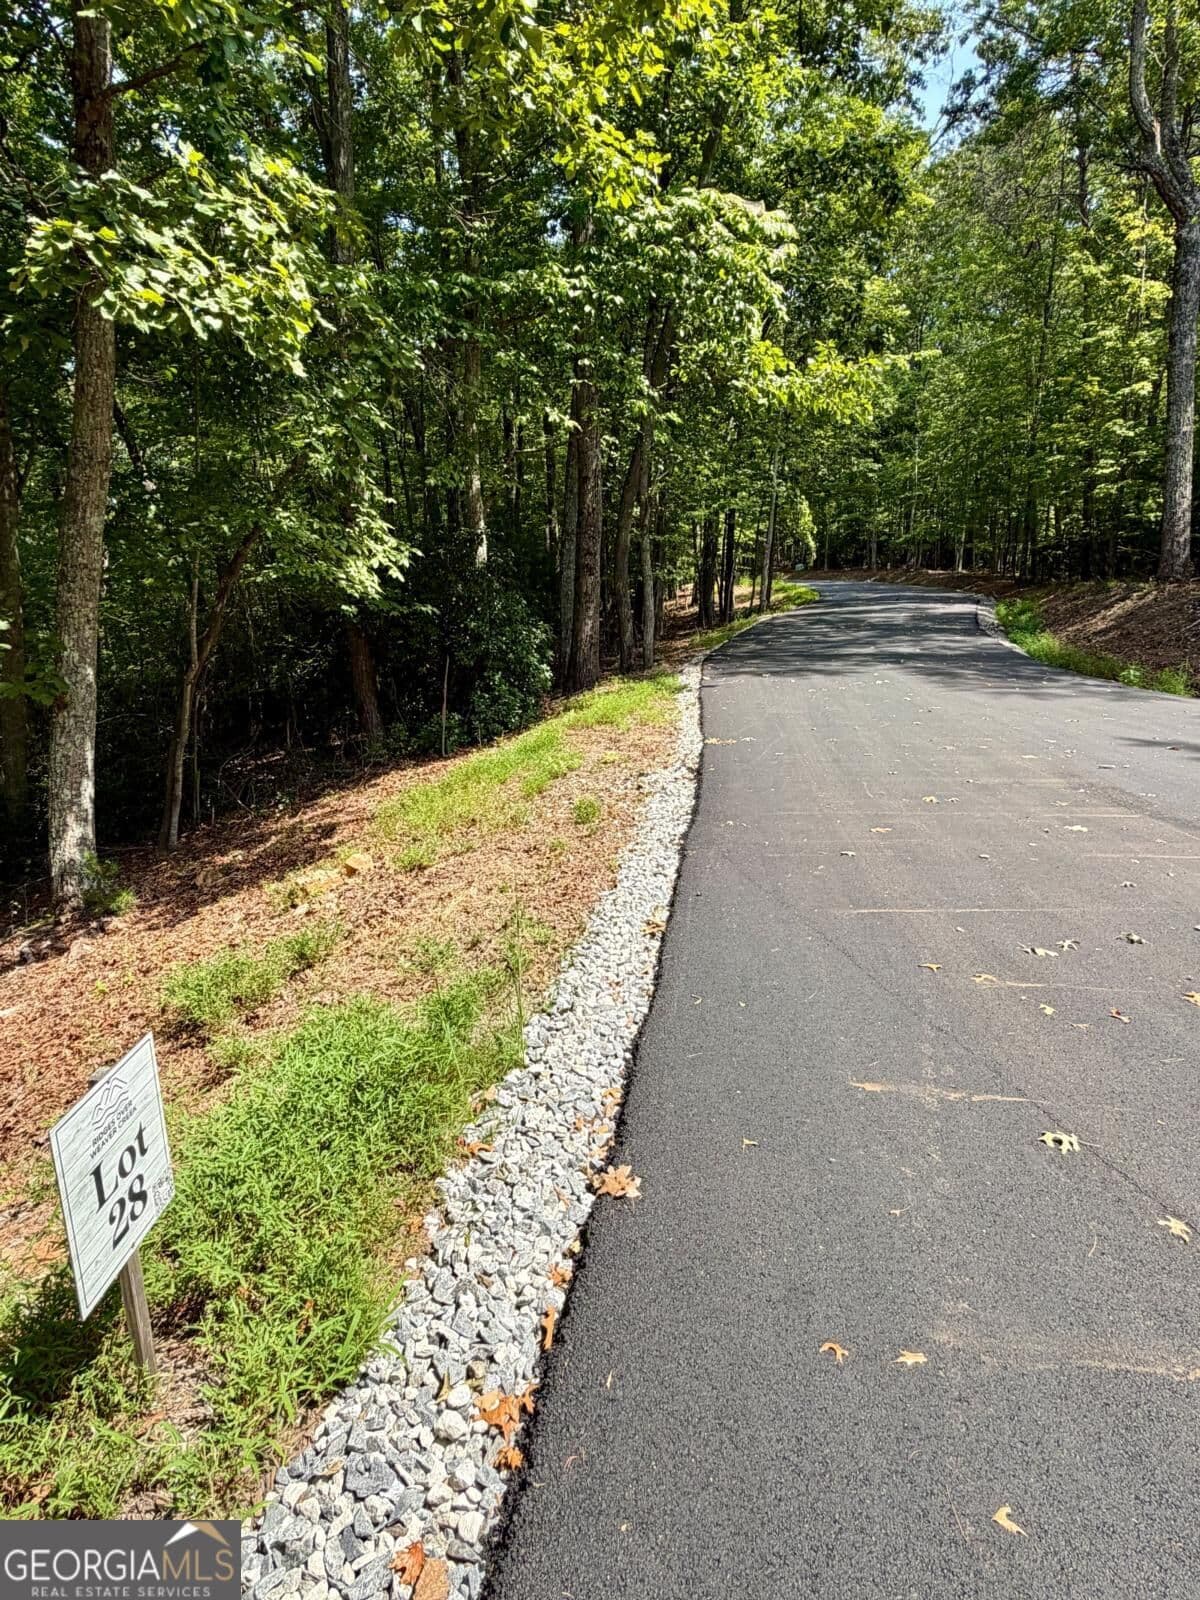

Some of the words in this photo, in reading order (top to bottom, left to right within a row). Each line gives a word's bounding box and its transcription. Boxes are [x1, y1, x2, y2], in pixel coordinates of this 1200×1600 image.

[90, 1128, 117, 1159] WEAVER
[92, 1119, 116, 1147] RIDGES
[116, 1100, 133, 1120] OVER
[90, 1121, 149, 1214] Lot
[109, 1174, 148, 1250] 28
